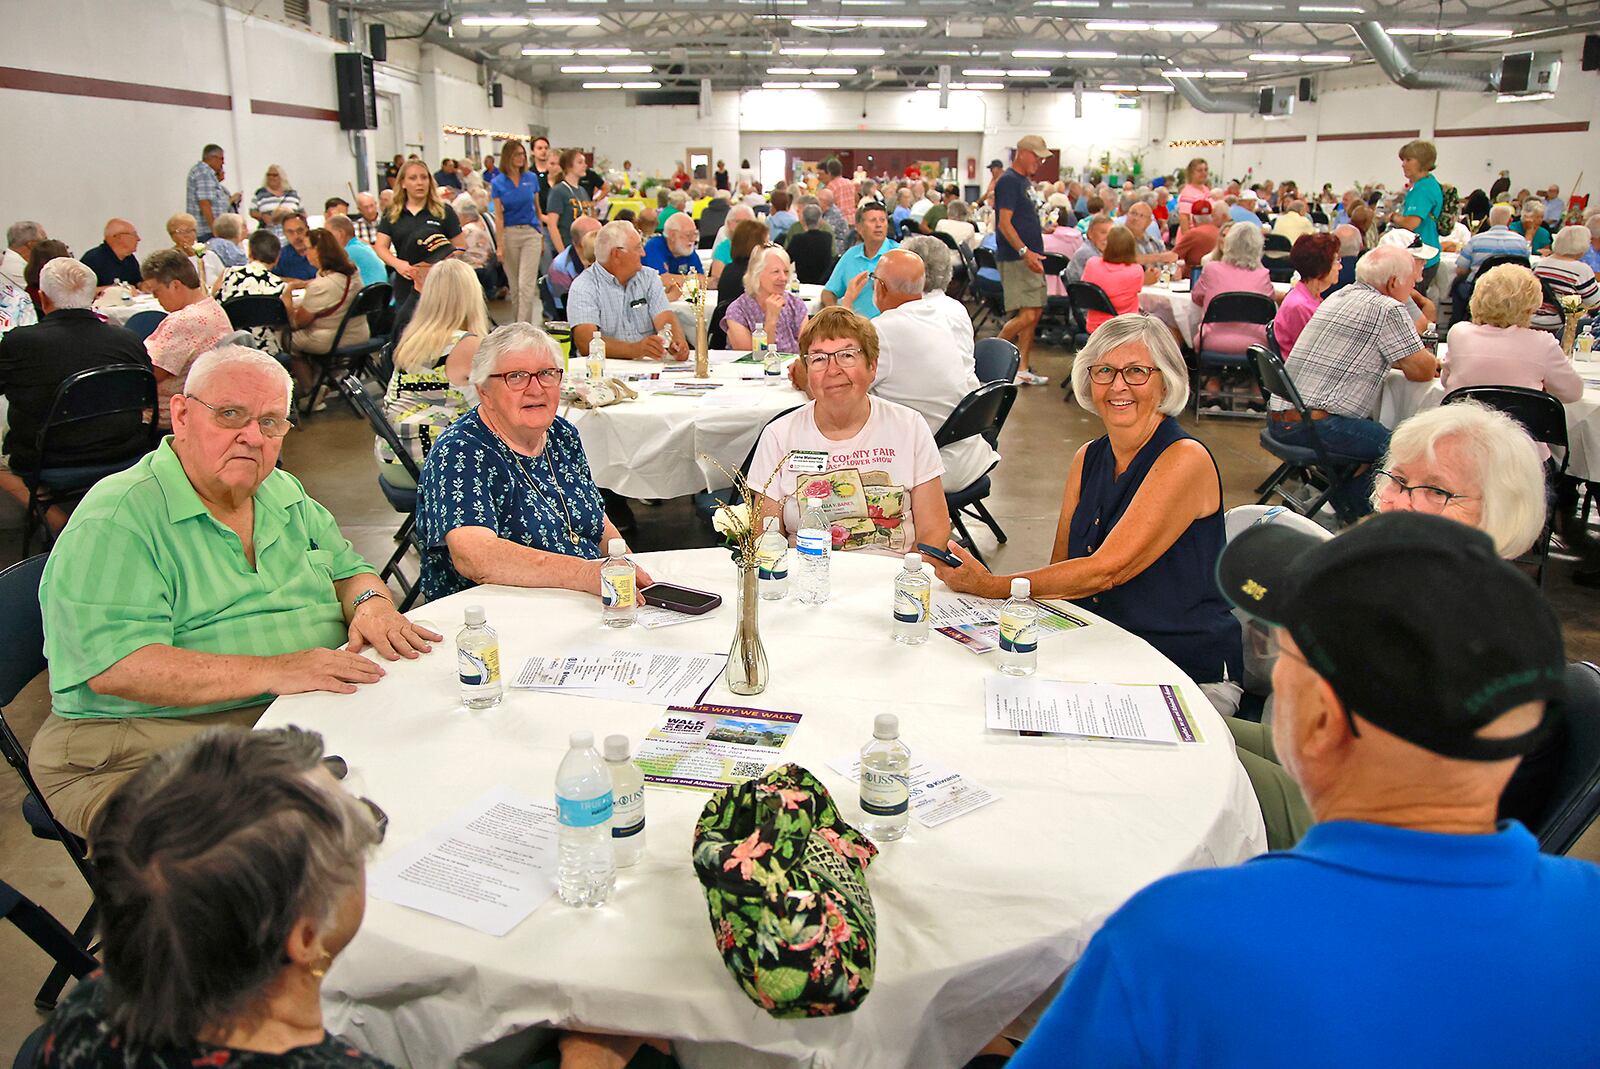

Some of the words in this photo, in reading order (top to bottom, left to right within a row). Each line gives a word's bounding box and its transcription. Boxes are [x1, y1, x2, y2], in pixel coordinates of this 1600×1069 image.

[873, 447, 896, 457] FAIR
[761, 712, 795, 720] WALK.
[667, 718, 706, 726] WALK
[693, 780, 732, 788] Alzheimer'
